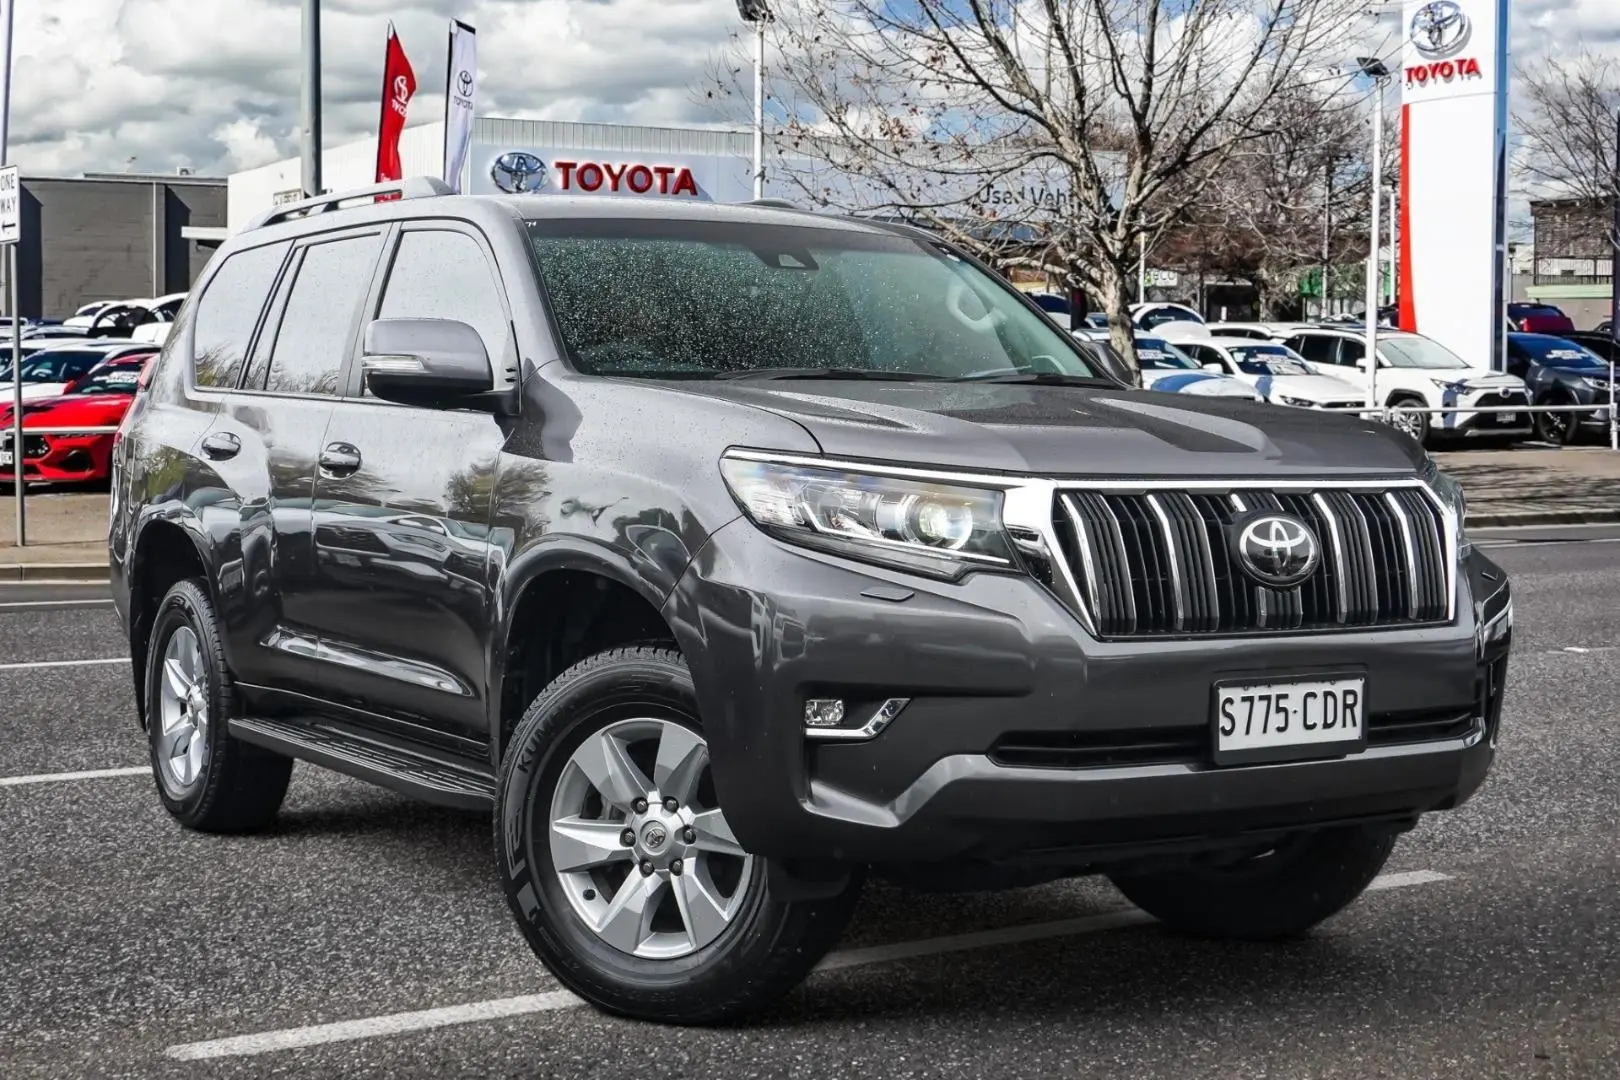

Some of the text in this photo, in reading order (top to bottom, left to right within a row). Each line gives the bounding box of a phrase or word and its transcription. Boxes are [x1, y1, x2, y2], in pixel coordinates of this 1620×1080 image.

[1404, 58, 1480, 83] TOYOTA
[1, 173, 15, 191] ONE
[555, 161, 698, 196] TOYOTA
[1, 196, 16, 213] WAY
